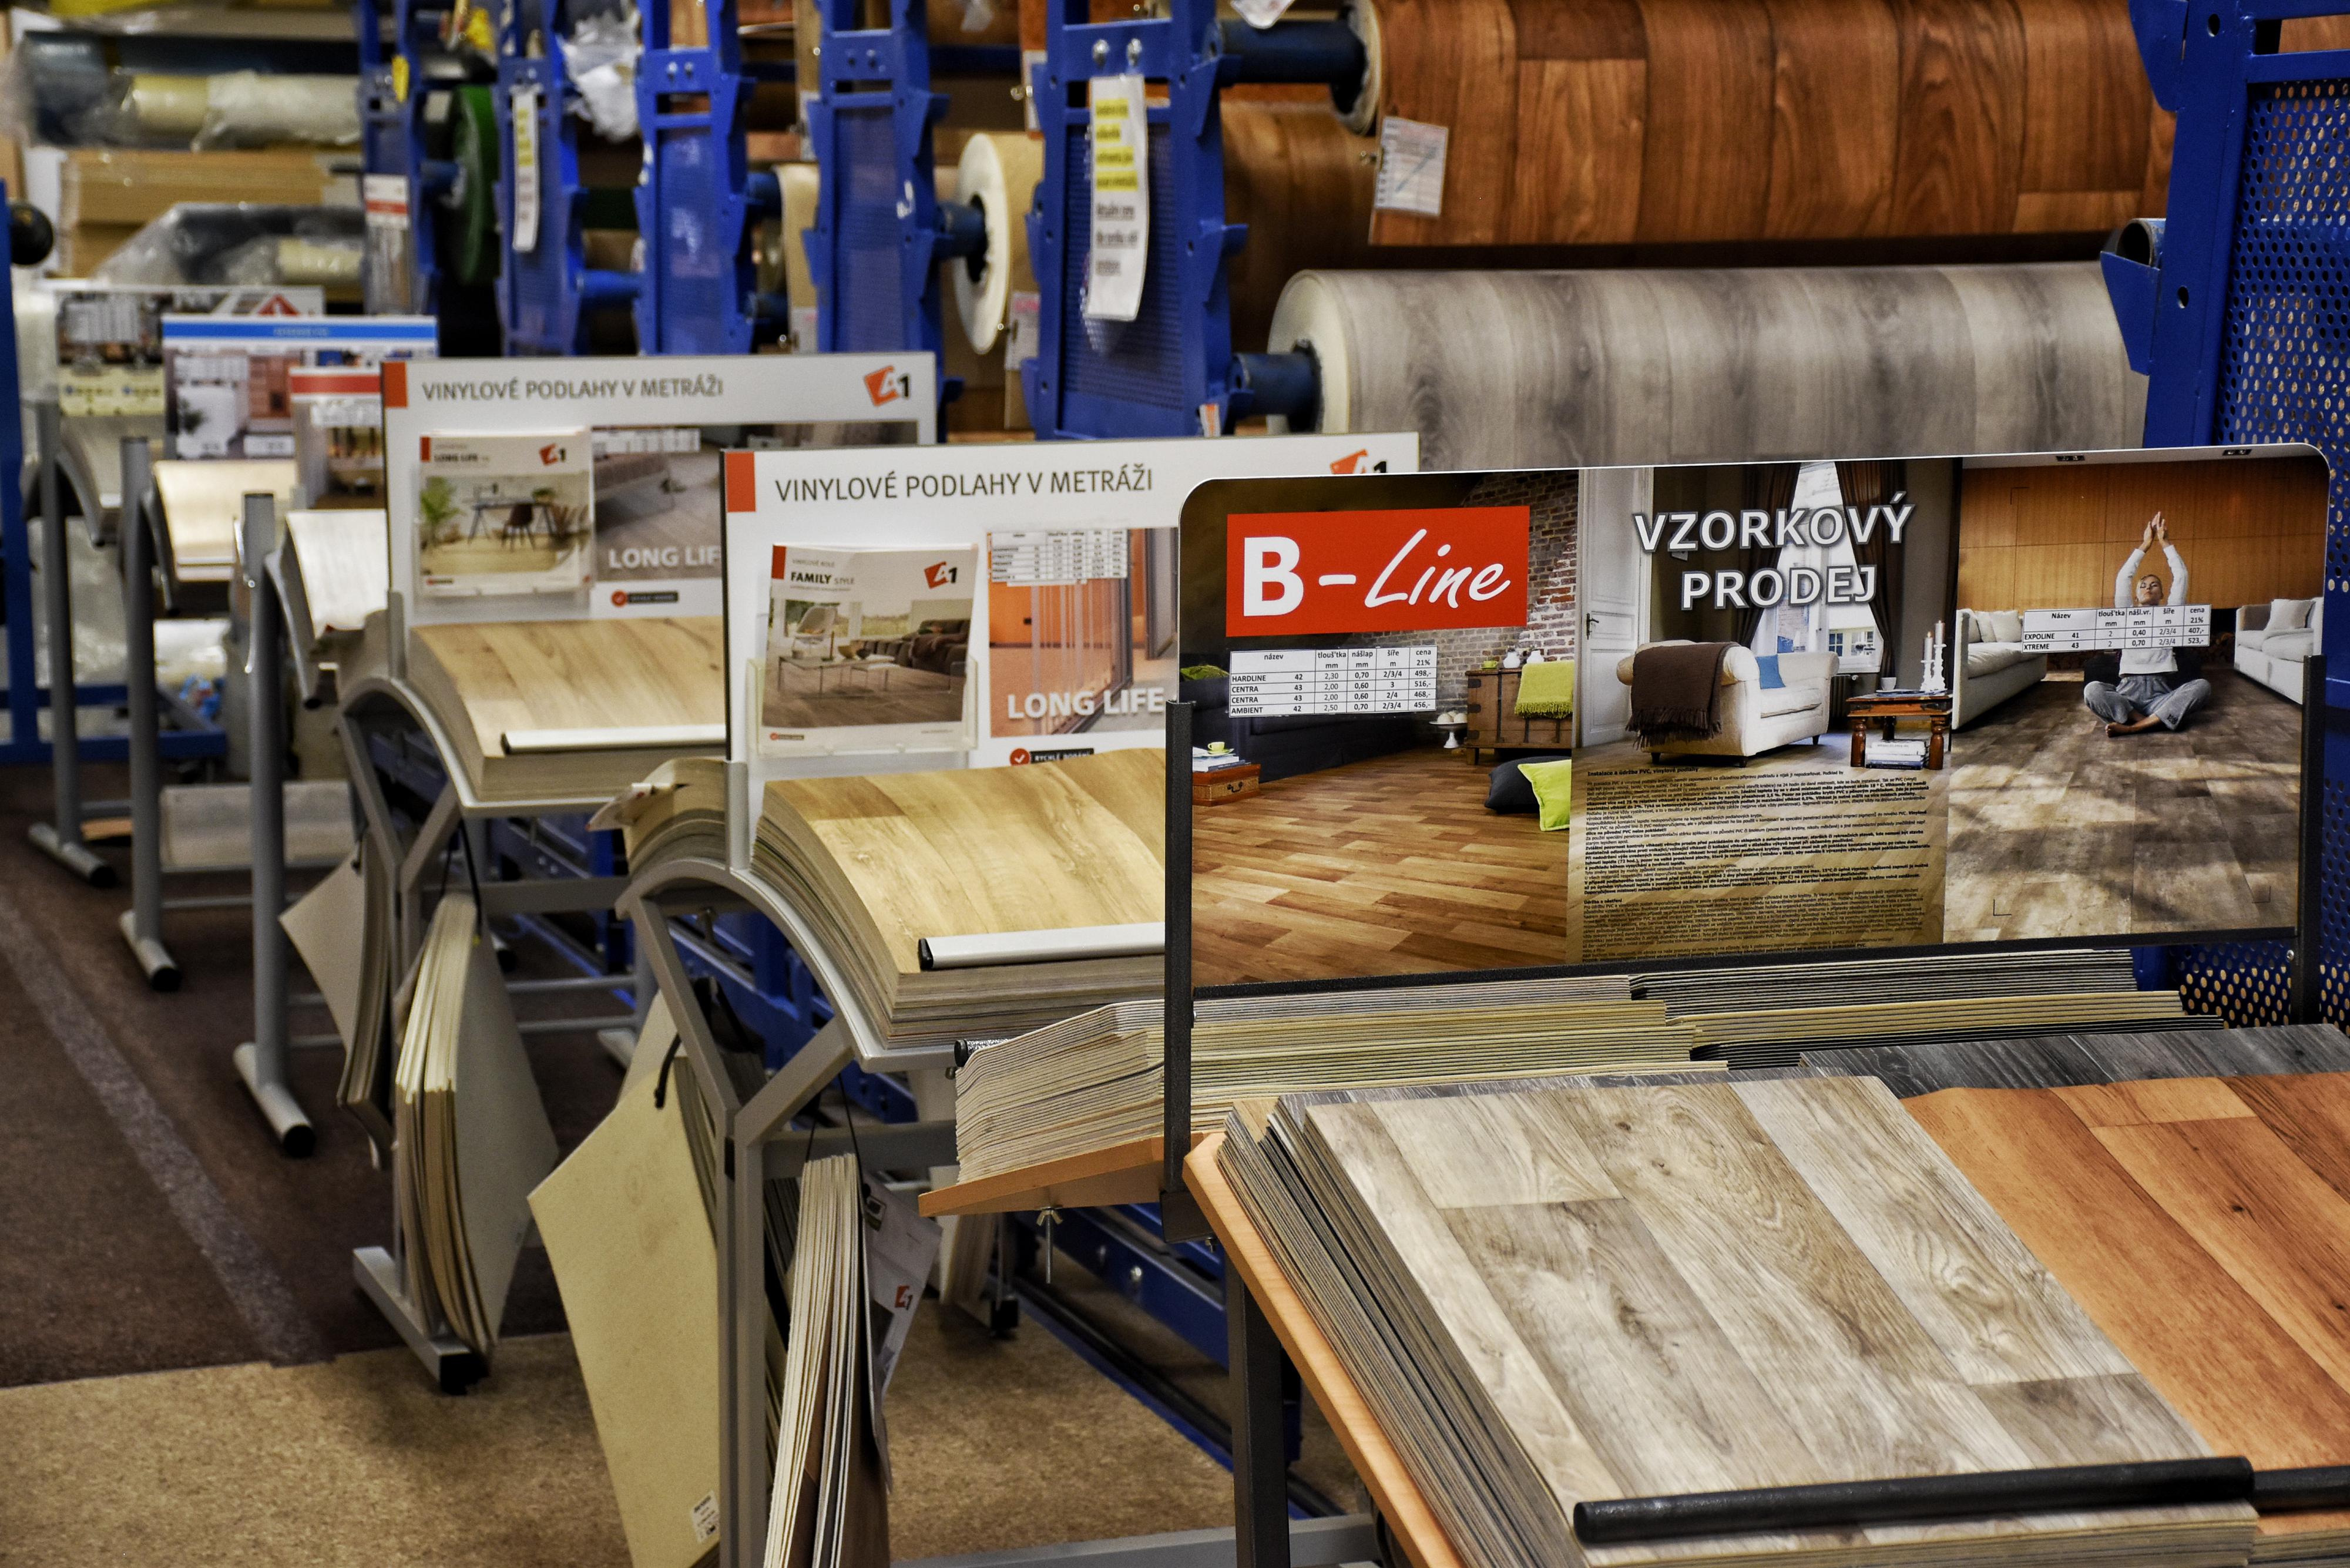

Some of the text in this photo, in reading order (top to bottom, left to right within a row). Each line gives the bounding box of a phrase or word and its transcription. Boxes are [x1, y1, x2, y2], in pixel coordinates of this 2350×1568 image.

[422, 374, 723, 400] VINYLOVÉ PODLAHY V METRÁŽI
[776, 464, 1153, 502] VINYLOVÉ PODLAHY V METRÁŽI
[1631, 491, 1916, 553] VZORKOVÝ
[609, 546, 720, 570] LONG LIF
[1243, 536, 1305, 616] B
[1364, 528, 1511, 609] Line
[791, 572, 832, 584] FAMILY
[1681, 564, 1877, 610] PRODEJ
[1008, 687, 1164, 720] LONG LIFE
